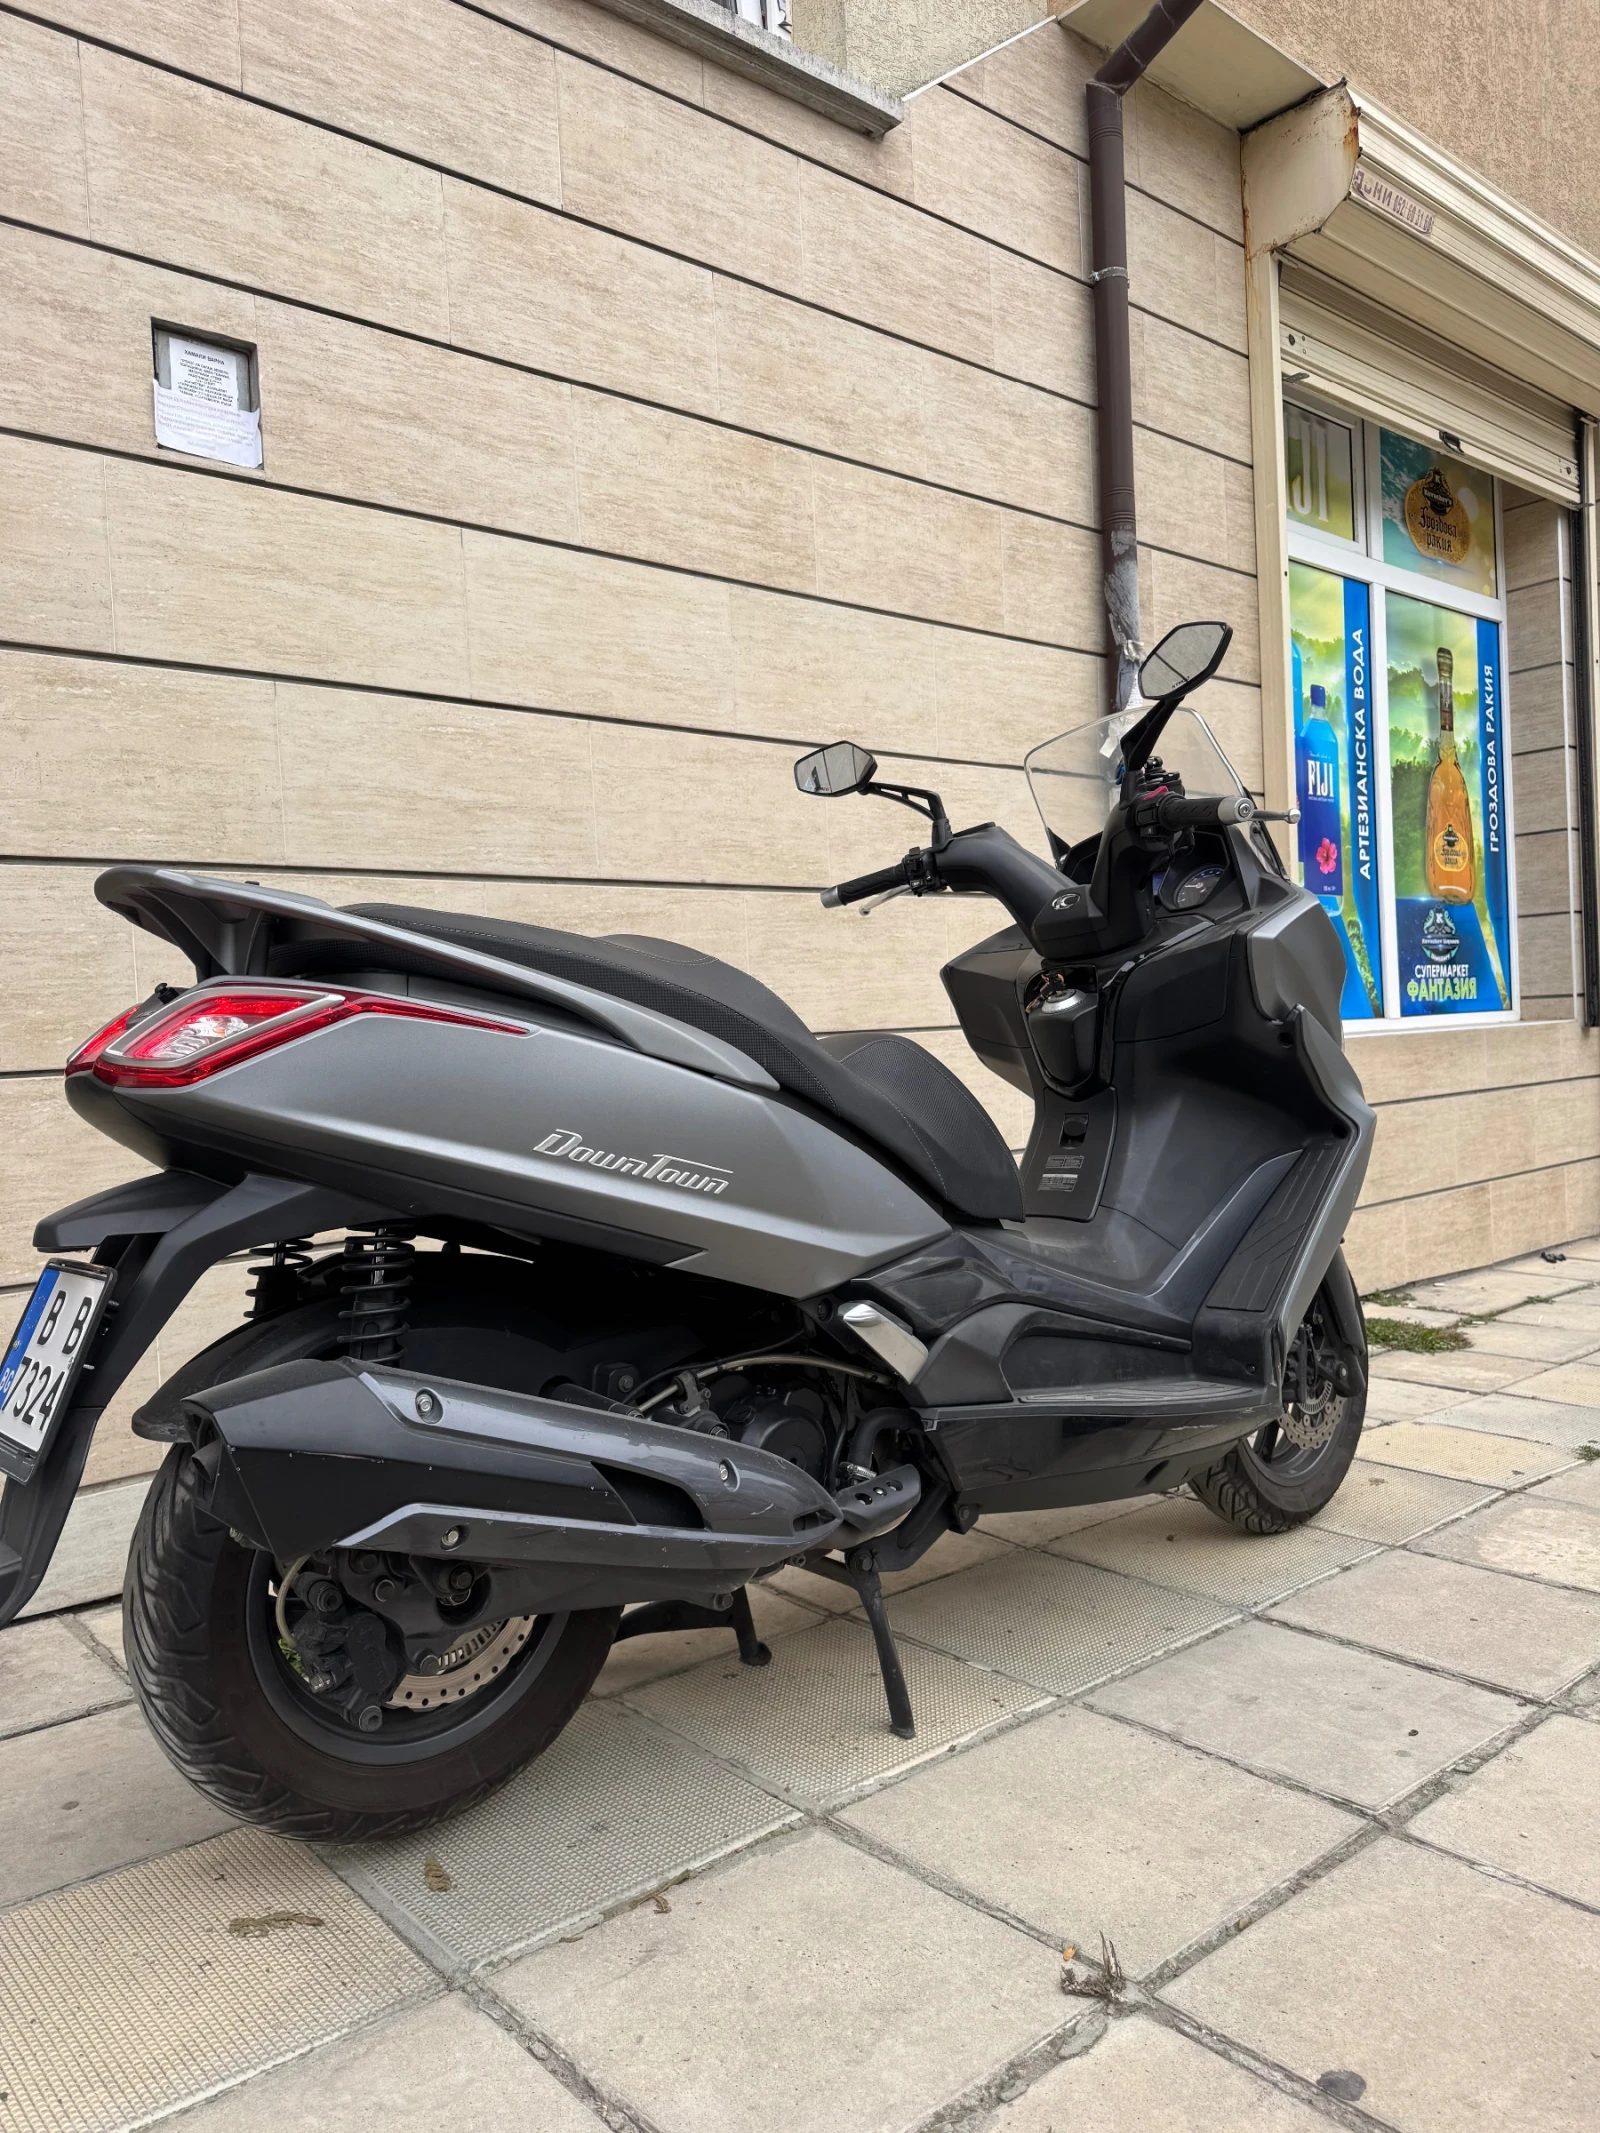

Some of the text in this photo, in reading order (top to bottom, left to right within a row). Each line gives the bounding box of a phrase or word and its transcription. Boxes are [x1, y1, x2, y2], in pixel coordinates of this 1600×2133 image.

[1426, 532, 1453, 554] ракия
[1352, 628, 1371, 881] АРТЕЗИАНСКА ВОДА
[1484, 665, 1499, 852] ГРОЗДОВА РАКИЯ
[1307, 759, 1334, 798] FIJI
[1406, 977, 1477, 1002] ФАНТАЗИЯ
[1414, 964, 1469, 978] СУПЕРМАРКЕТ
[533, 1128, 734, 1194] DownTown
[0, 1366, 15, 1394] BG
[1, 1356, 66, 1432] 7324
